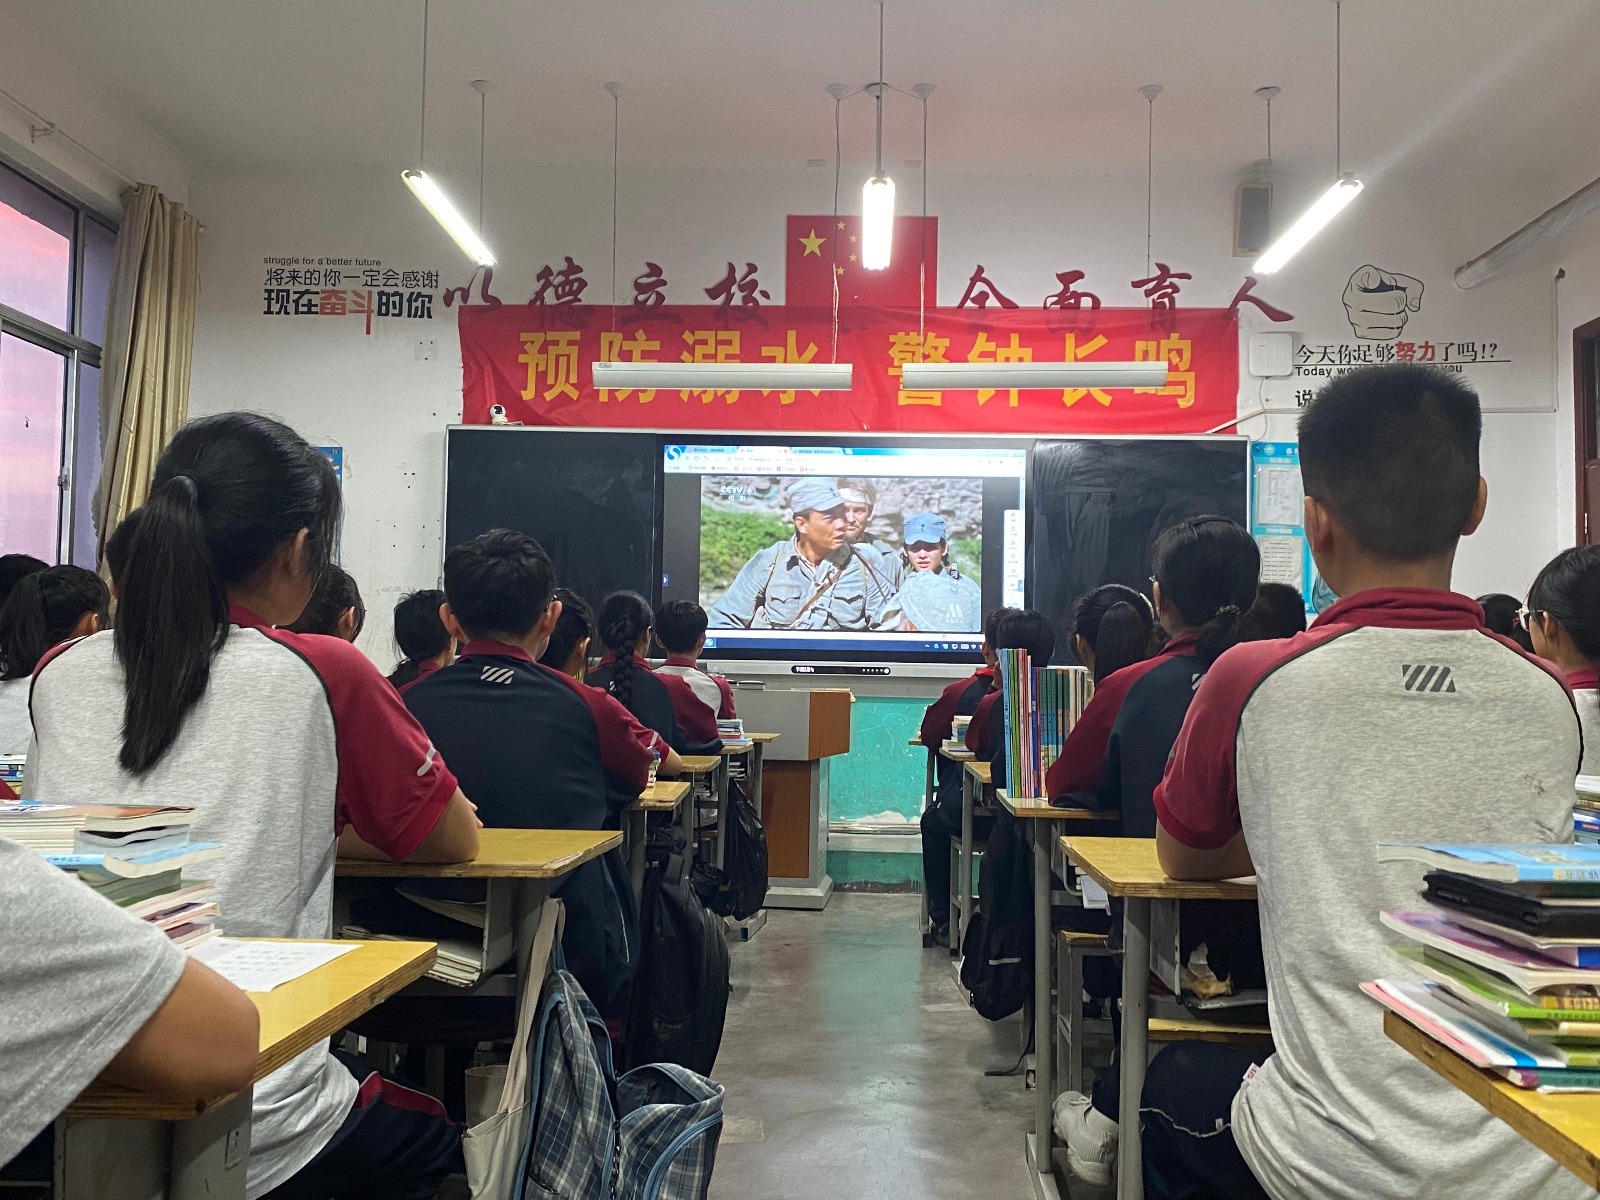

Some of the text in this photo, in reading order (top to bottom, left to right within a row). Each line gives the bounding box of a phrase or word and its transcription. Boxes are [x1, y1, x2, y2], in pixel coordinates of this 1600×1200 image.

[263, 257, 300, 266] struggle
[302, 257, 315, 265] for
[326, 257, 353, 266] better
[355, 258, 382, 266] future
[264, 268, 440, 289] 将来的你一定会感谢
[263, 288, 433, 335] 现在奋斗的你
[518, 329, 1196, 409] 预防溺水 警钟长鸣
[1294, 366, 1332, 378] Today
